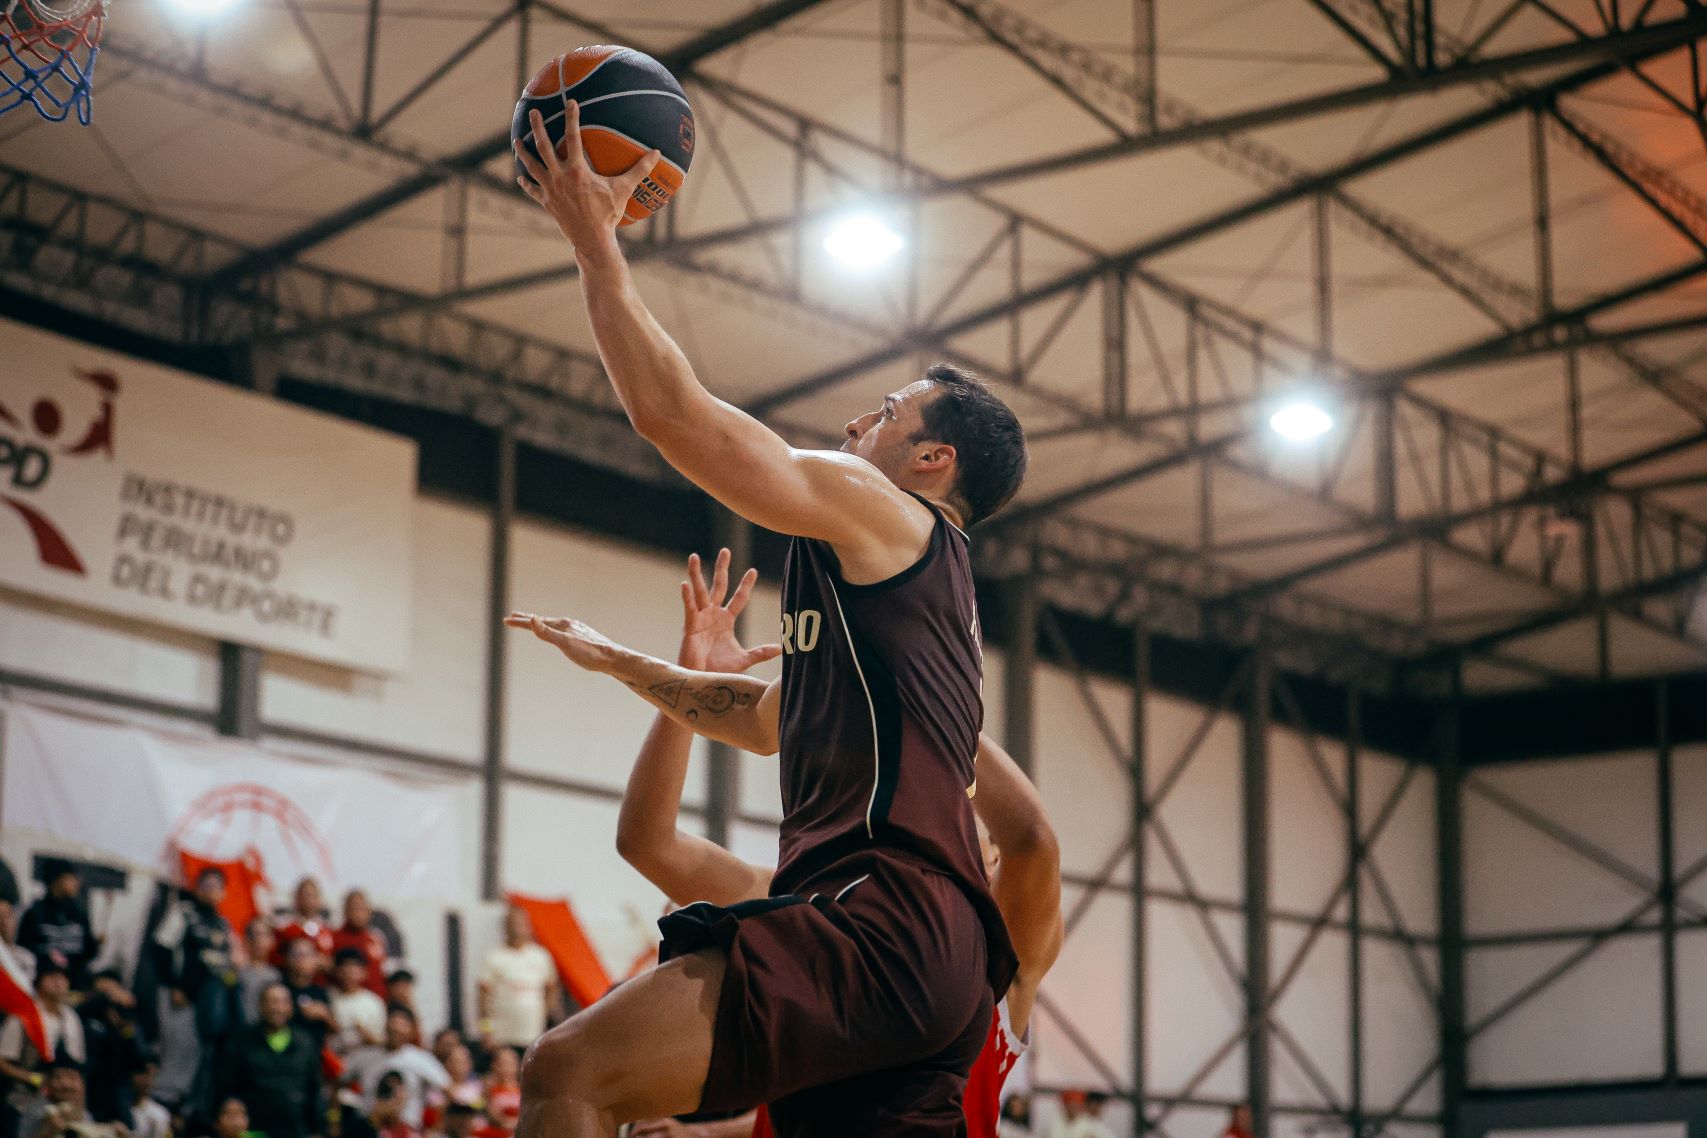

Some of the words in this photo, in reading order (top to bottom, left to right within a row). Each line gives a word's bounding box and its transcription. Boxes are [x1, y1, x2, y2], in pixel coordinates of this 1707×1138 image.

[116, 511, 281, 583] PERUANO
[119, 472, 295, 547] INSTITUTO
[111, 553, 174, 600] DEL
[186, 572, 338, 639] DEPORTE
